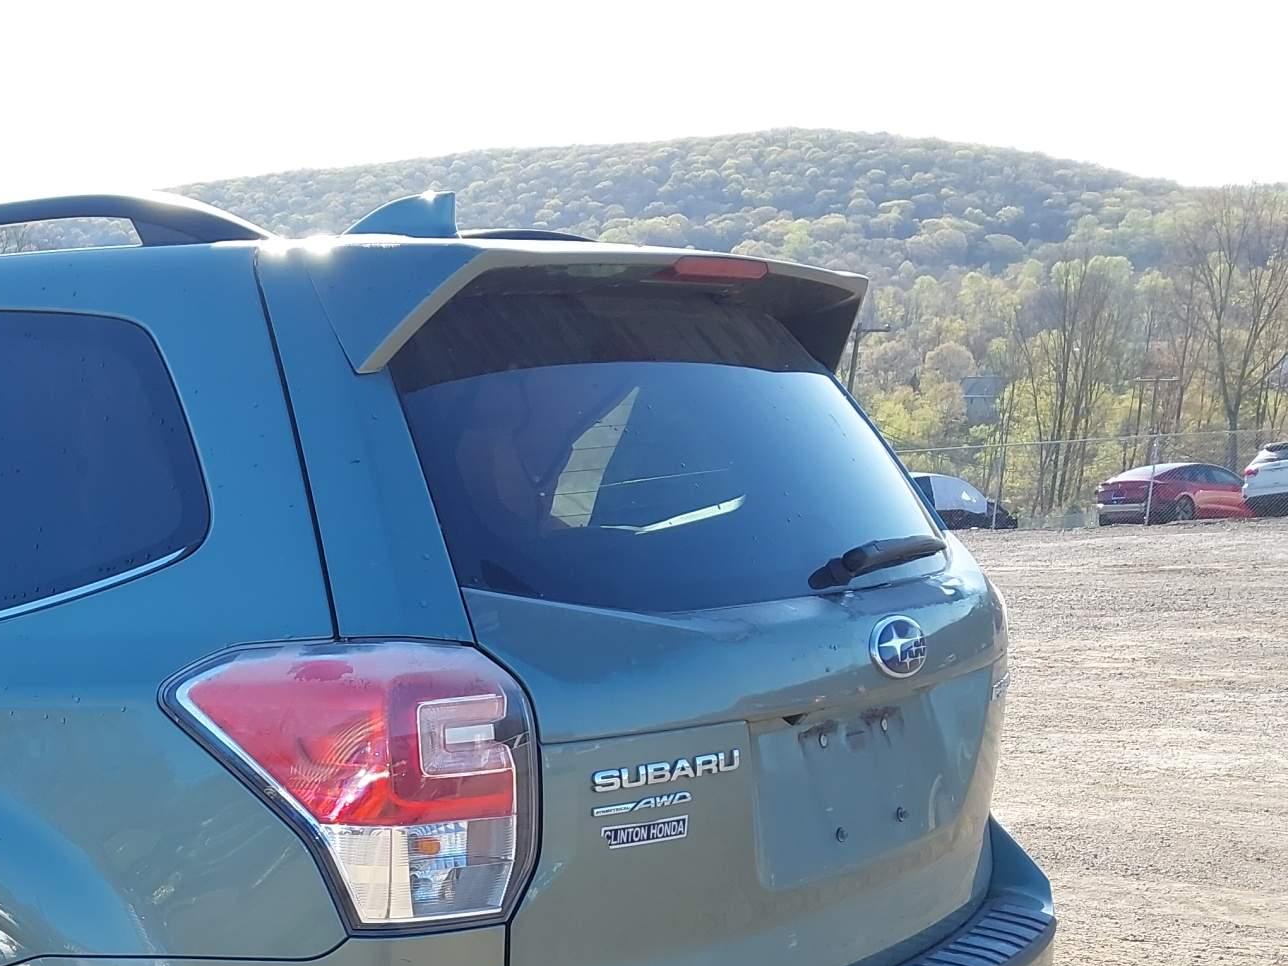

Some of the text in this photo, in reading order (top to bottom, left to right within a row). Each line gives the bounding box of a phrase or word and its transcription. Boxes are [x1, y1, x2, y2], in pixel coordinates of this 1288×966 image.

[592, 749, 740, 792] SUBARU
[633, 792, 693, 811] AWD
[604, 820, 685, 845] CLINTON HONDA
